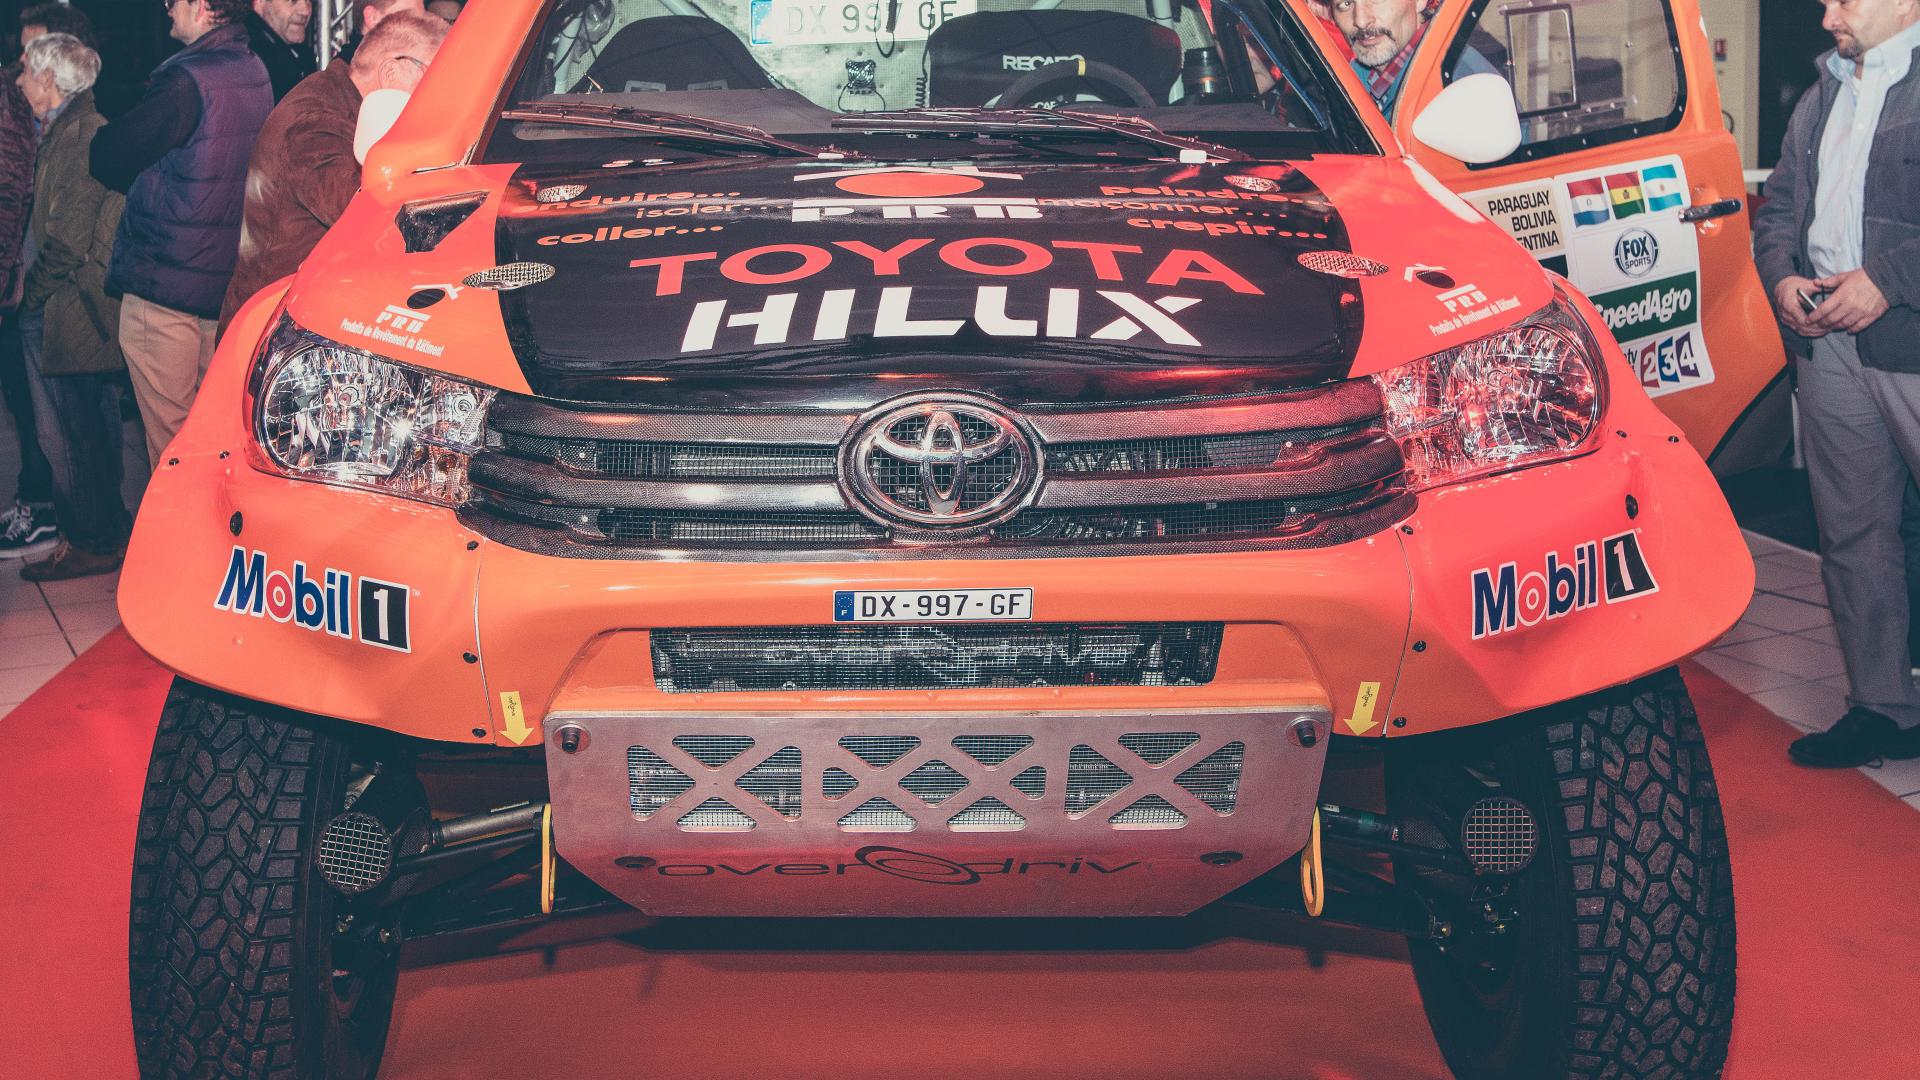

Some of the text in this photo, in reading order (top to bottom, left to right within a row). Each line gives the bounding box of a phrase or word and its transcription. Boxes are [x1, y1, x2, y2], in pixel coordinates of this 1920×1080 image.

[1488, 190, 1551, 216] PARAGUAY
[1126, 218, 1328, 239] crepir...
[1511, 209, 1557, 232] BOLIVIA
[536, 225, 724, 246] coller...
[1622, 236, 1650, 261] FOX
[629, 236, 1266, 296] TOYOTA
[1624, 257, 1652, 270] SPORTS
[680, 285, 1203, 353] HILUX
[214, 545, 352, 639] Mobil
[1471, 539, 1599, 640] Mobil
[861, 593, 1025, 617] DX-997-GF
